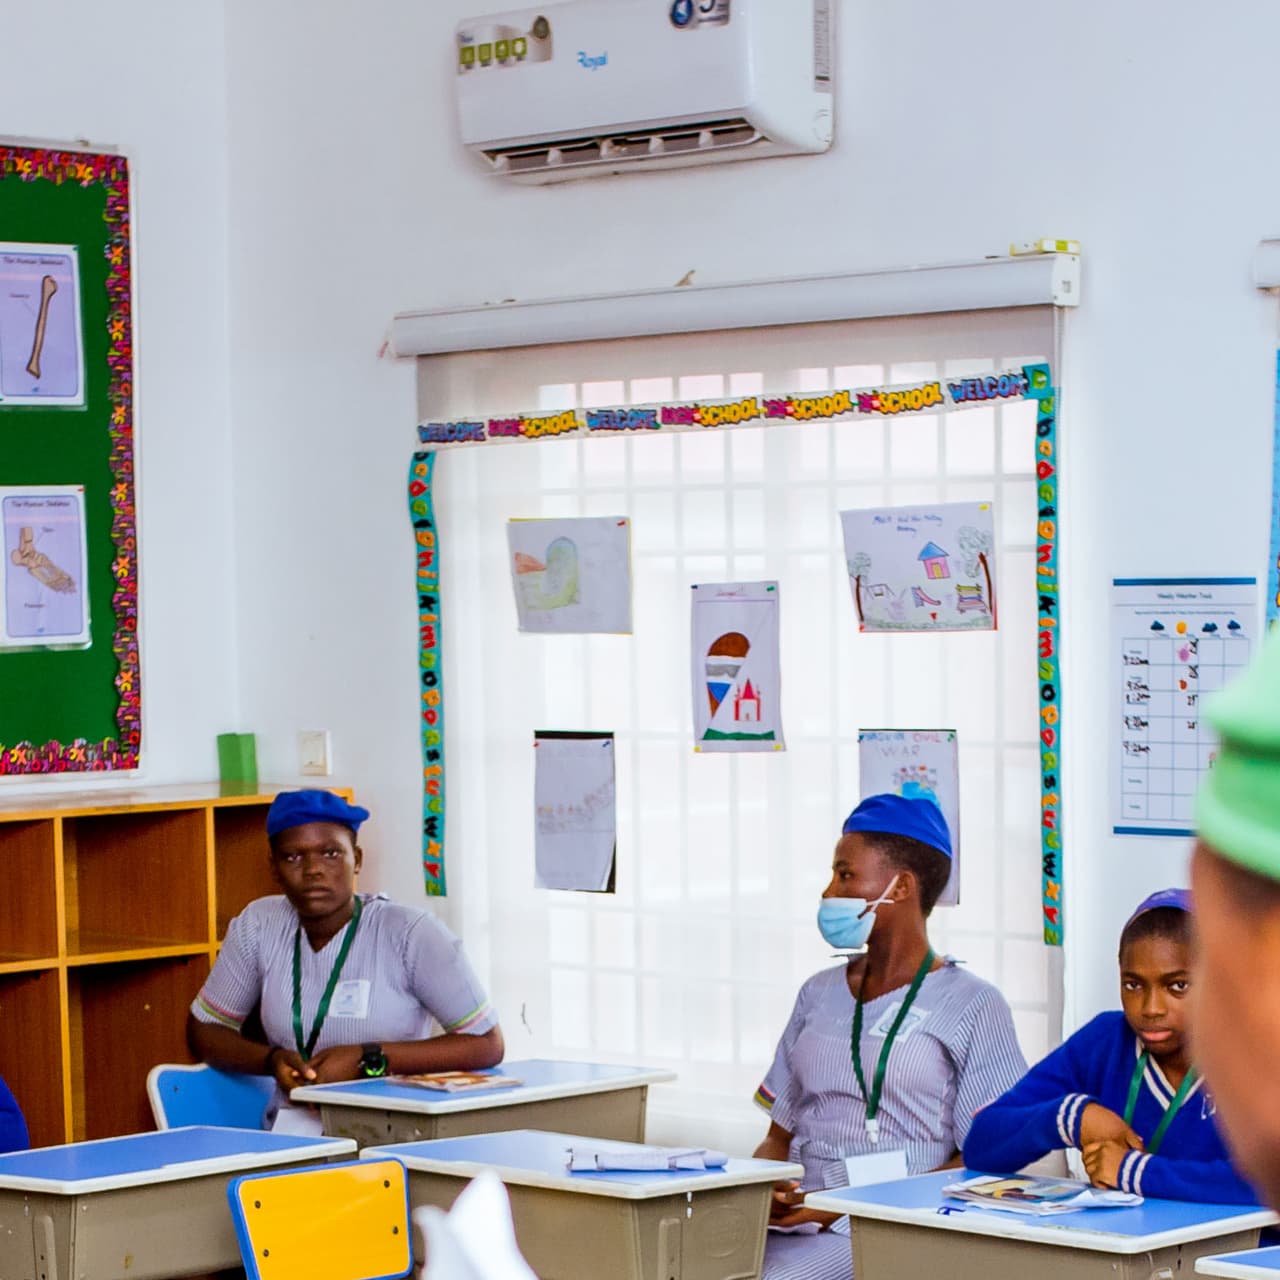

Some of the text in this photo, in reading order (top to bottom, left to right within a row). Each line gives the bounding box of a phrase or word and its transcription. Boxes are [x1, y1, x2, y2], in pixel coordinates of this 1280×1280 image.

[576, 51, 608, 72] Royal
[419, 421, 486, 443] WELCOME
[523, 410, 579, 438] SCHOOL
[586, 409, 660, 431] WELCOME
[698, 397, 759, 427] SCHOOL
[792, 390, 853, 420] SCHOOL
[879, 382, 943, 415] SCHOOL
[948, 373, 1030, 403] WELCOM
